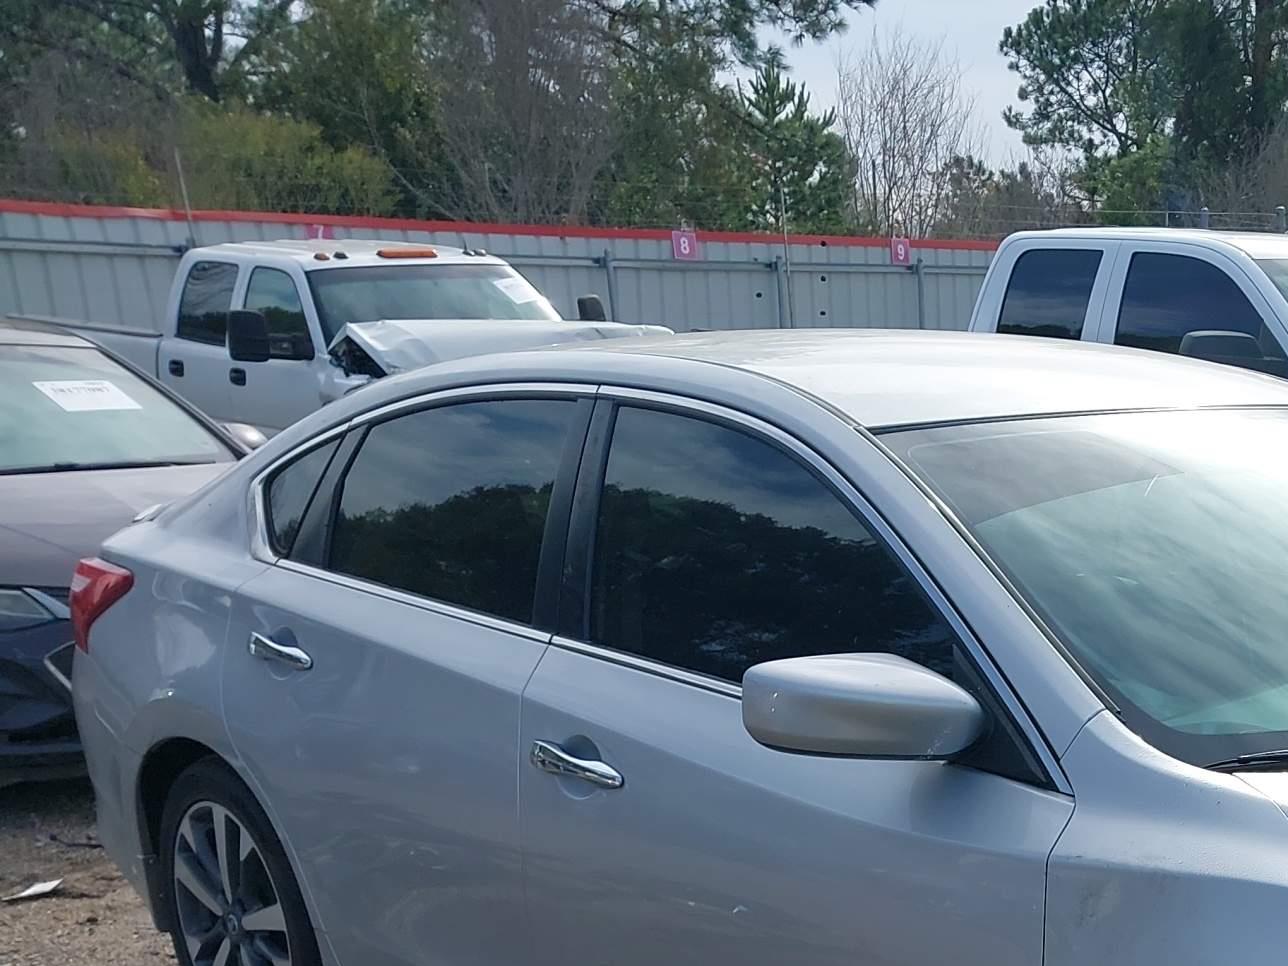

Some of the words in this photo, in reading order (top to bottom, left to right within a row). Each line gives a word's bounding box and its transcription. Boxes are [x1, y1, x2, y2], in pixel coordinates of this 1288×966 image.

[312, 224, 324, 239] 7
[680, 236, 689, 254] 8
[897, 244, 905, 260] 9
